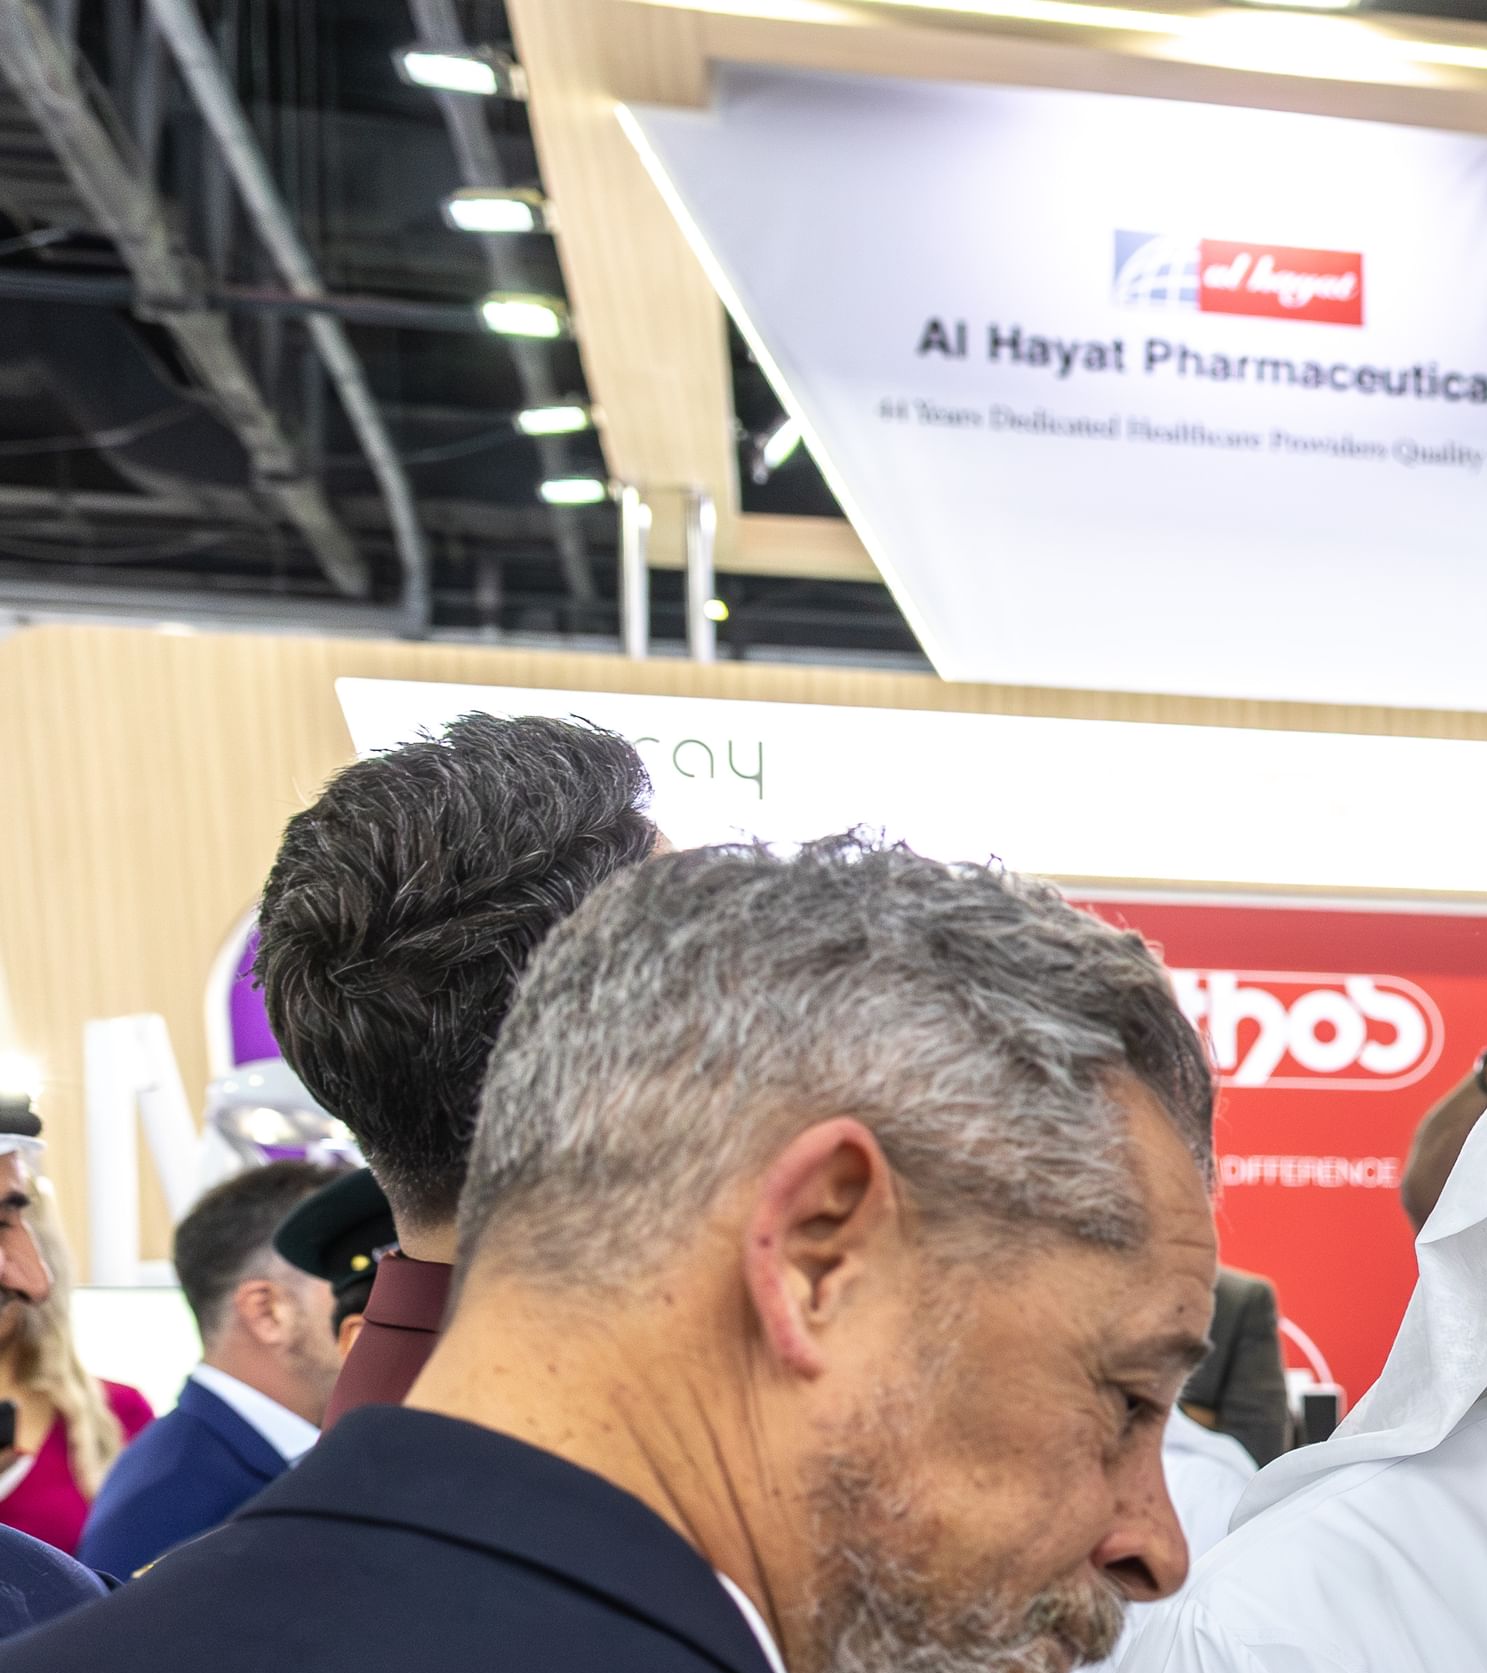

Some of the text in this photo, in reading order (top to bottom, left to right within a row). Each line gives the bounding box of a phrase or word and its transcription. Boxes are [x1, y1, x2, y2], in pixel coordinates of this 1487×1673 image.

[917, 317, 967, 358] Al
[988, 322, 1126, 379] Hayat
[1219, 1154, 1401, 1188] DIFFERENCE
